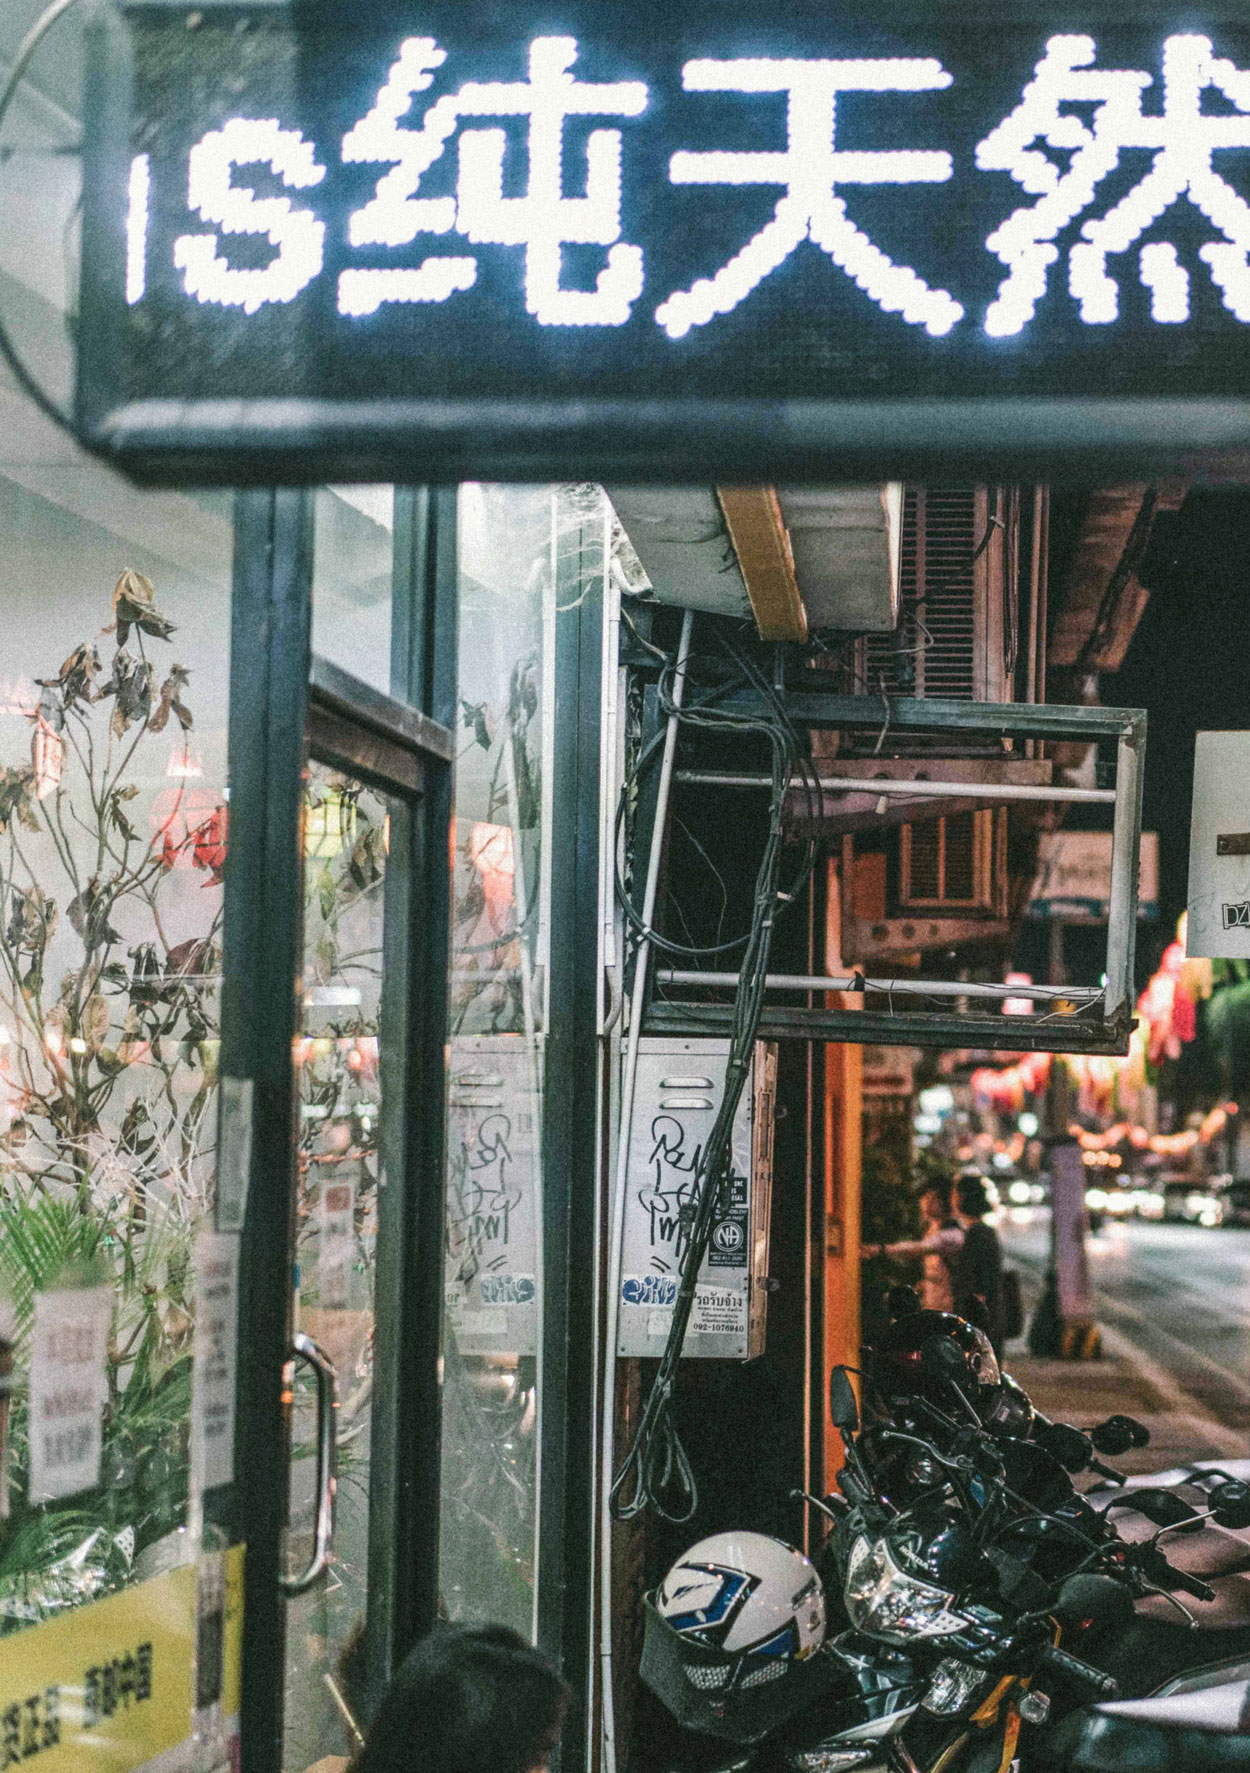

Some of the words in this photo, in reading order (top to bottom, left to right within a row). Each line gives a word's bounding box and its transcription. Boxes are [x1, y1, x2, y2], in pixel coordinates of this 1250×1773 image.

[717, 1225, 740, 1248] NA
[696, 1291, 743, 1307] รถรับจ้าง
